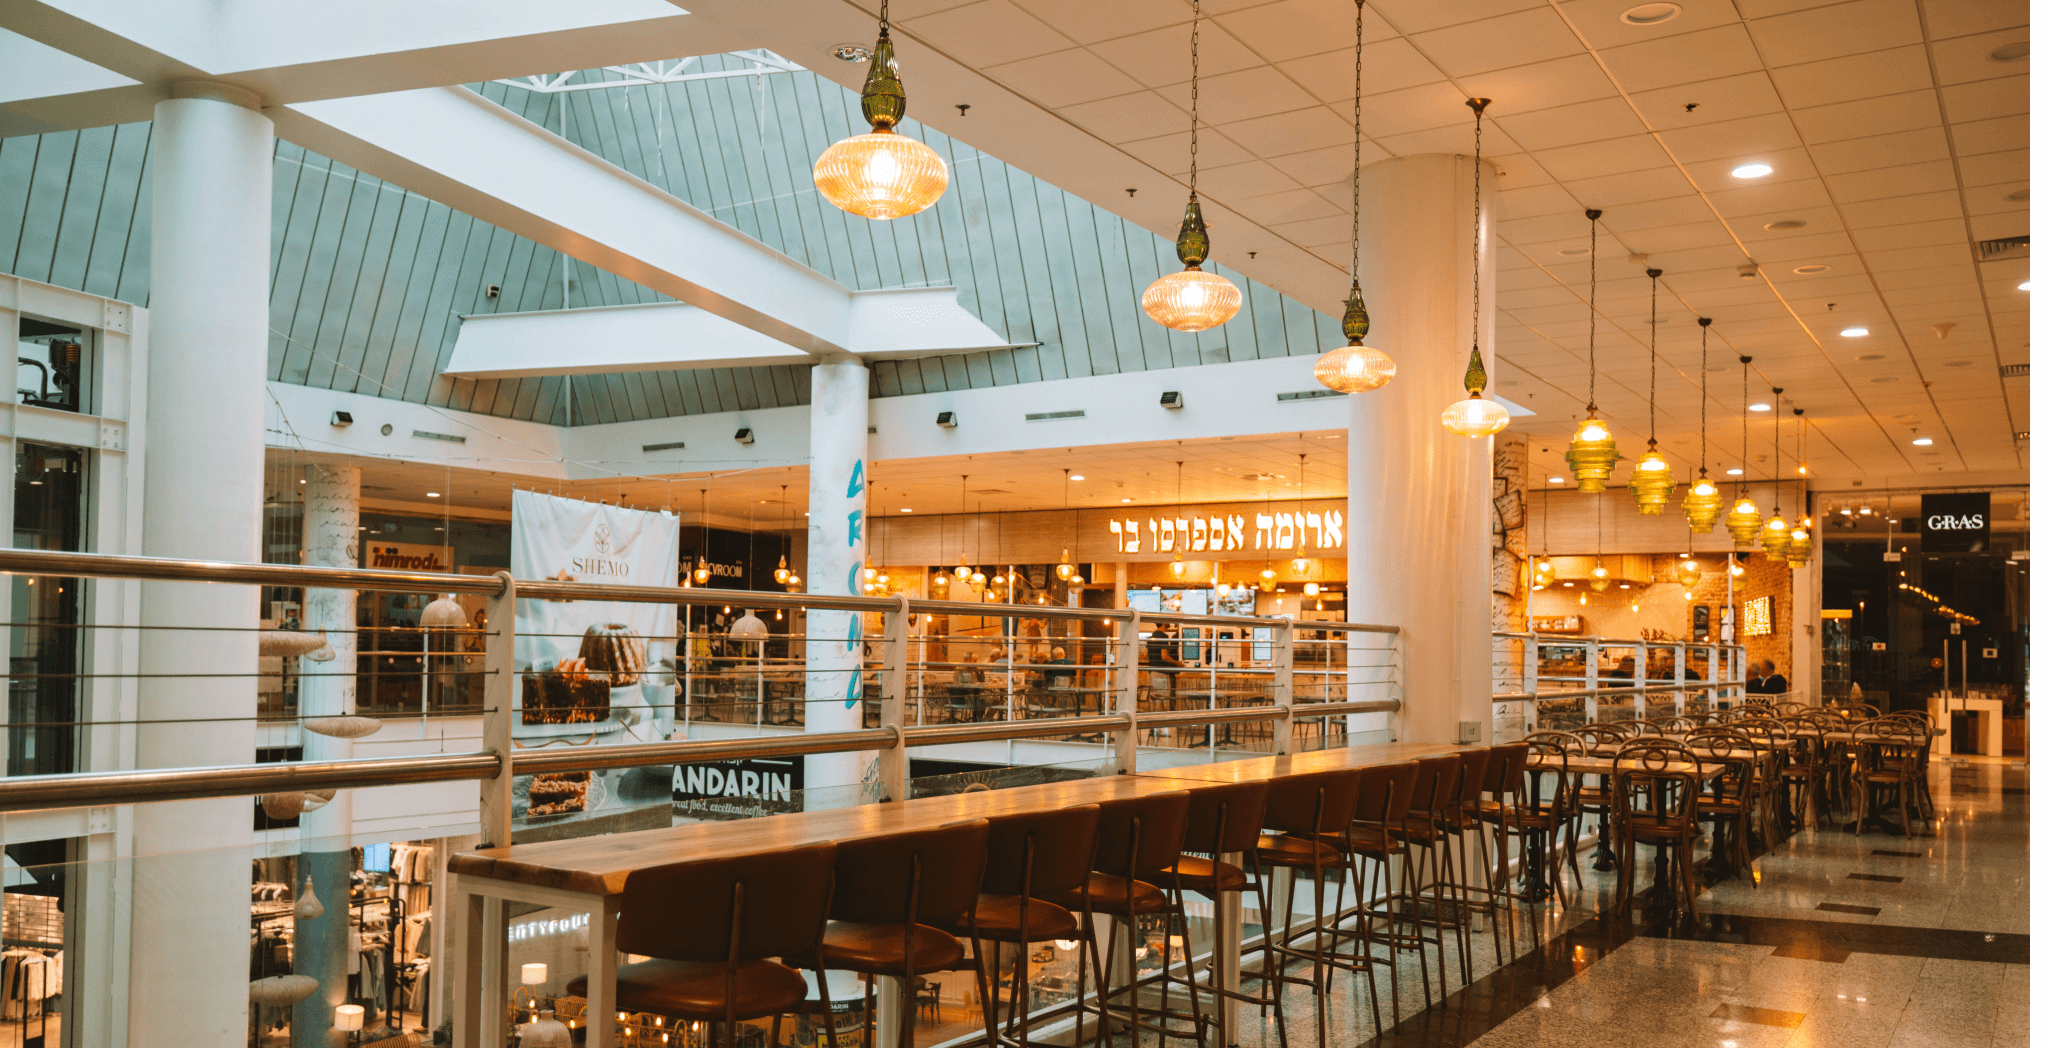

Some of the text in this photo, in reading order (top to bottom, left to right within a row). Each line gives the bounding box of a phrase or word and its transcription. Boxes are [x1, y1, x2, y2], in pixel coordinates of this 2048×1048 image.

[1109, 509, 1343, 553] ארומה אספרסו בר
[372, 552, 434, 570] nimrod
[572, 556, 629, 577] SHEMO
